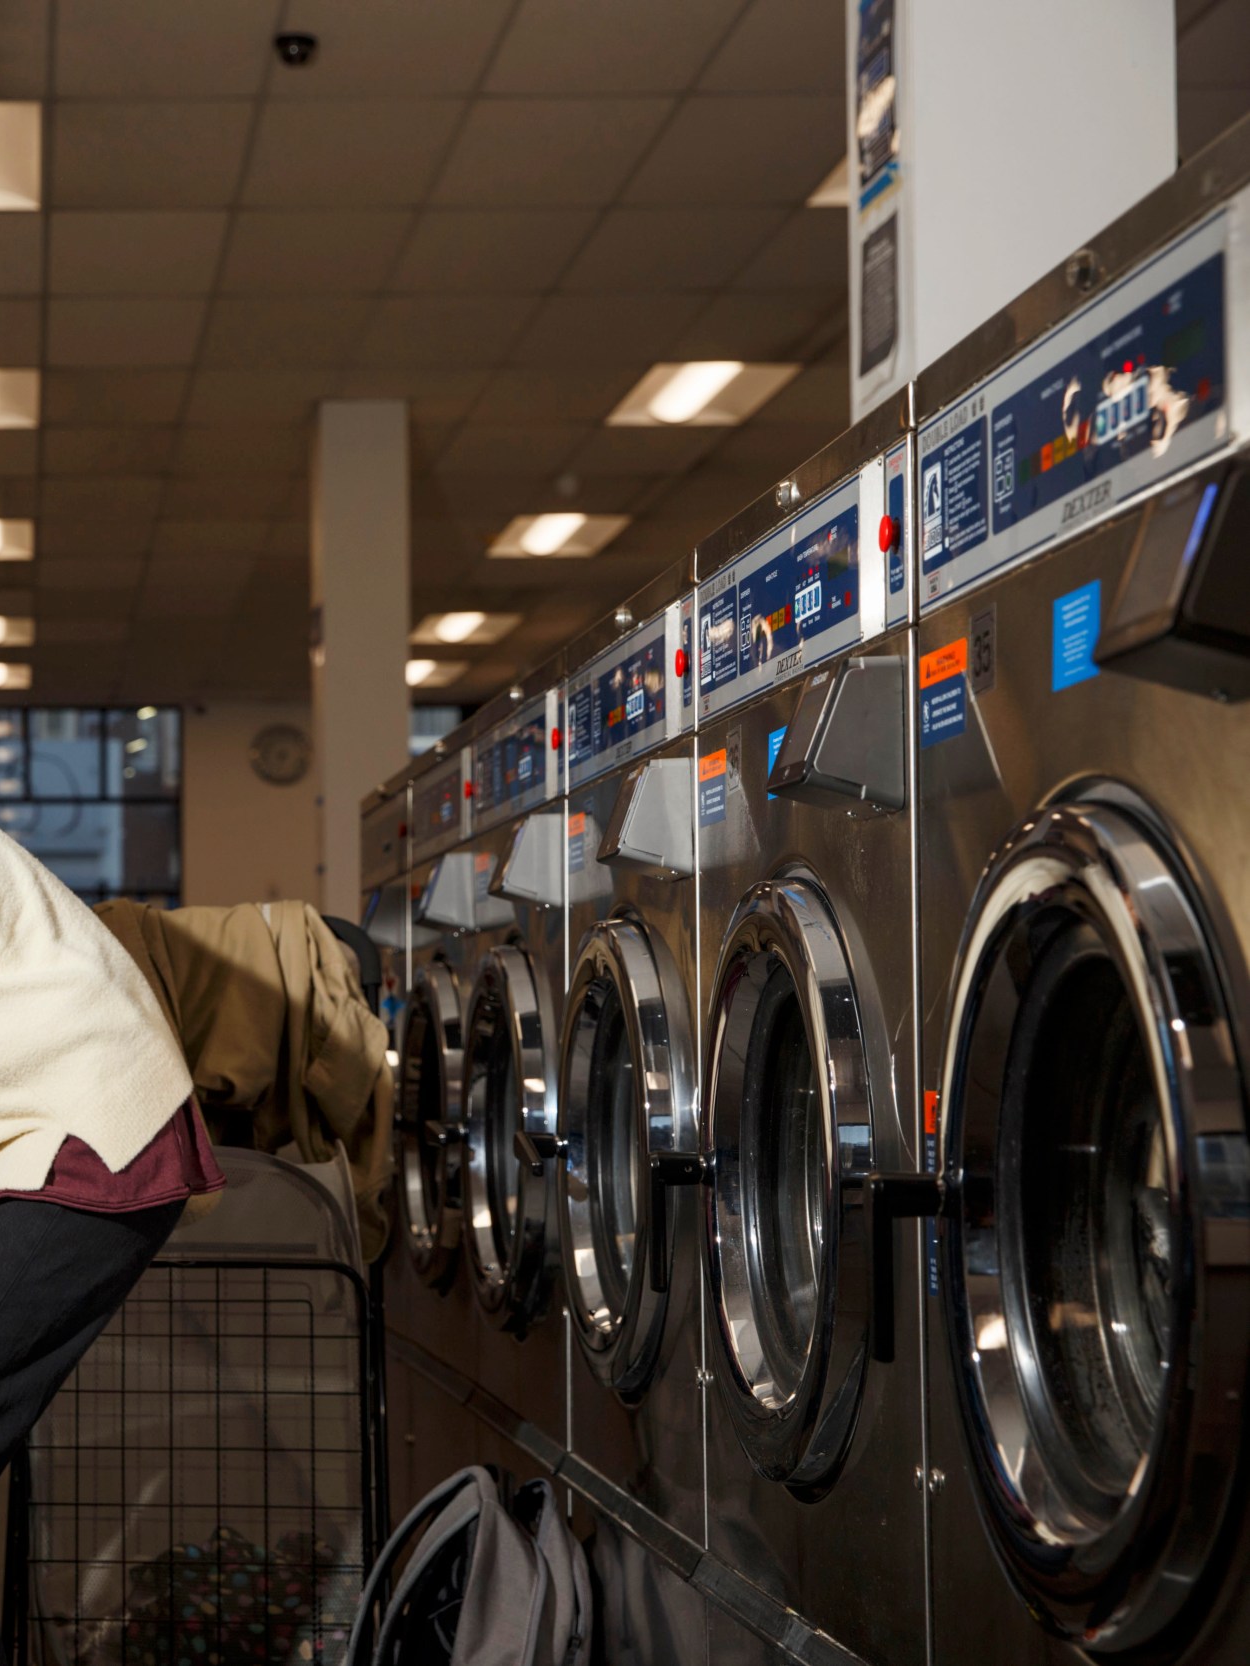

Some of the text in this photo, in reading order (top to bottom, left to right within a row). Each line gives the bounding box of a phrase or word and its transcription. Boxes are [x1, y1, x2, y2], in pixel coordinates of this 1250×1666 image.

[1062, 479, 1111, 523] DEXTER
[776, 649, 802, 676] DEXTER
[974, 630, 991, 677] 35
